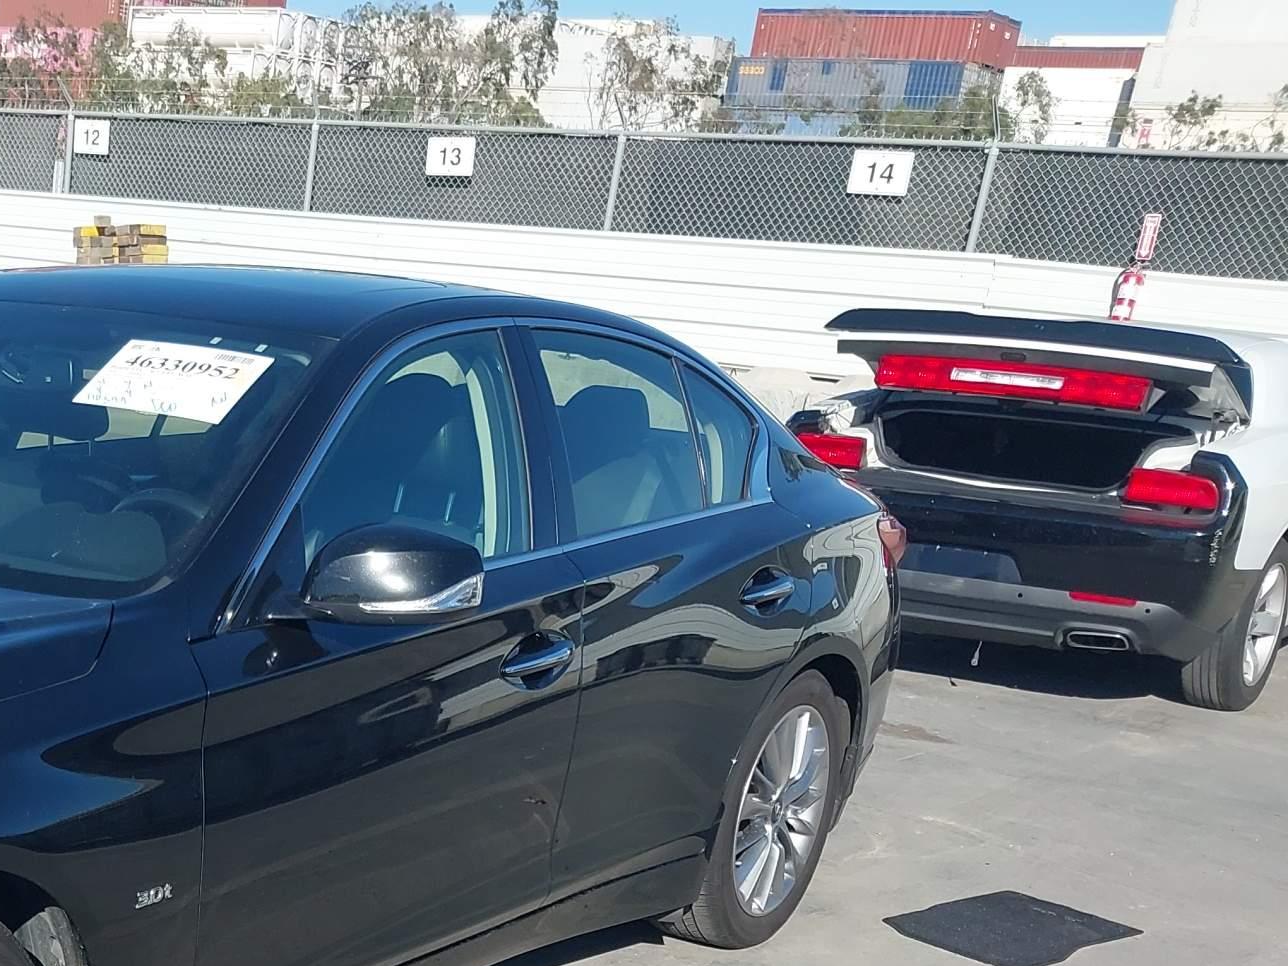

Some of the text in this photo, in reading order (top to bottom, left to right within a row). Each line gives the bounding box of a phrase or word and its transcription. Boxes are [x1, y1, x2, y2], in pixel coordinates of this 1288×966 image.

[84, 129, 100, 146] 12
[440, 147, 461, 166] 13
[867, 162, 895, 184] 14
[125, 354, 241, 380] 46330952
